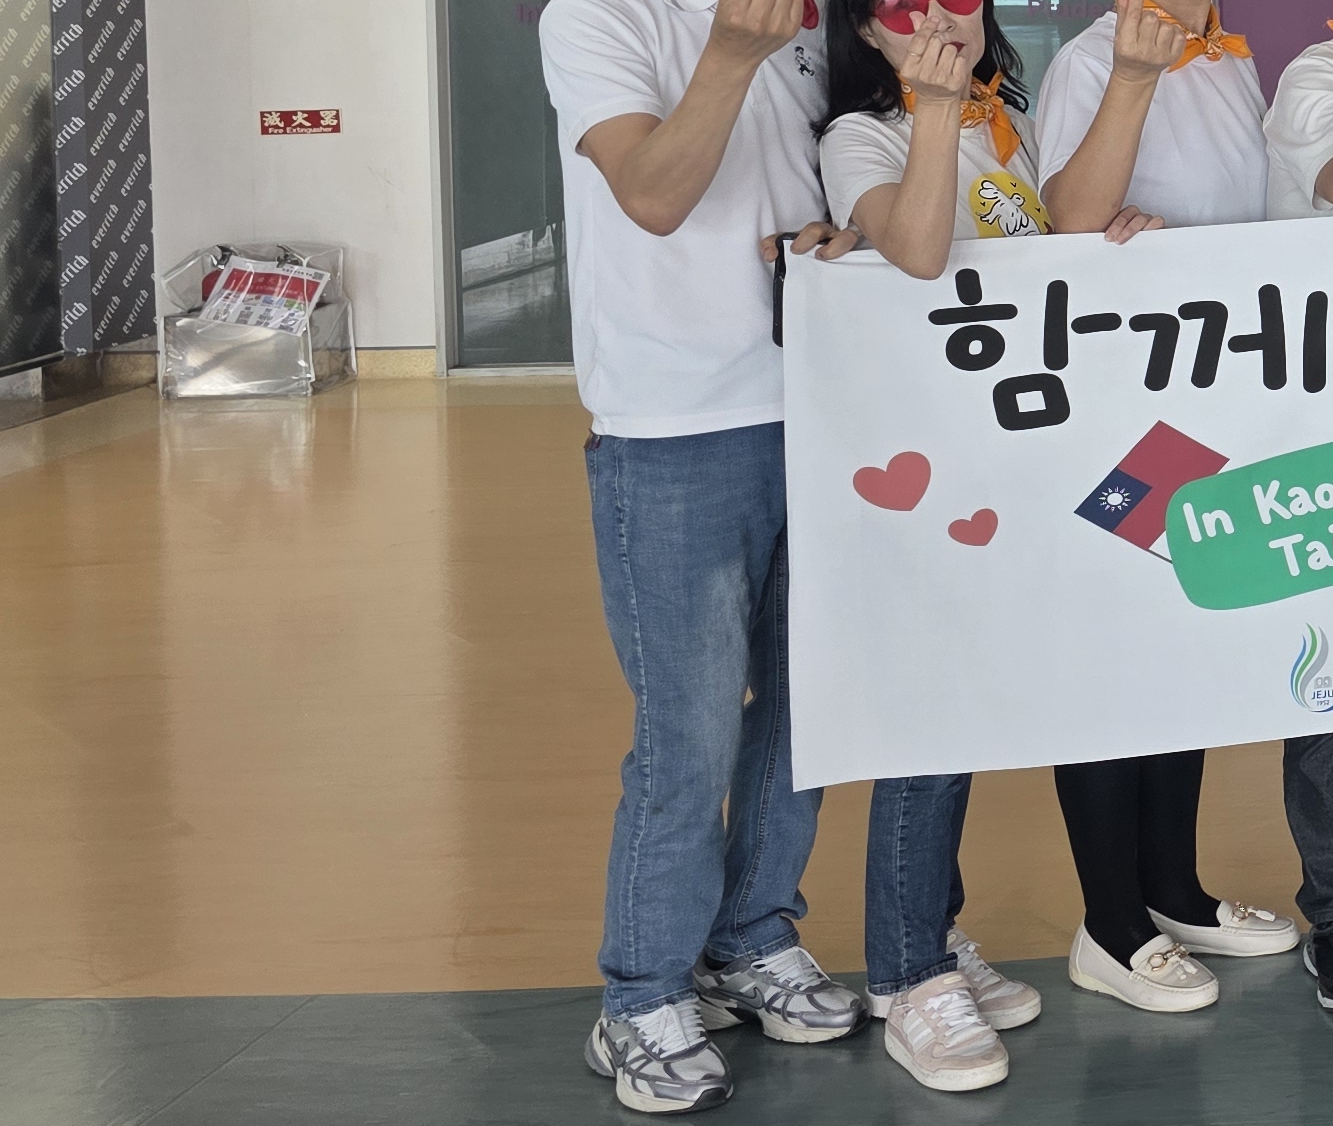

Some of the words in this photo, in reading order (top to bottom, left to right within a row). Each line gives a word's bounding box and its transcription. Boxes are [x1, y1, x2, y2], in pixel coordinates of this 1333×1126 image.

[262, 110, 338, 128] 滅火器
[1182, 501, 1235, 544] In
